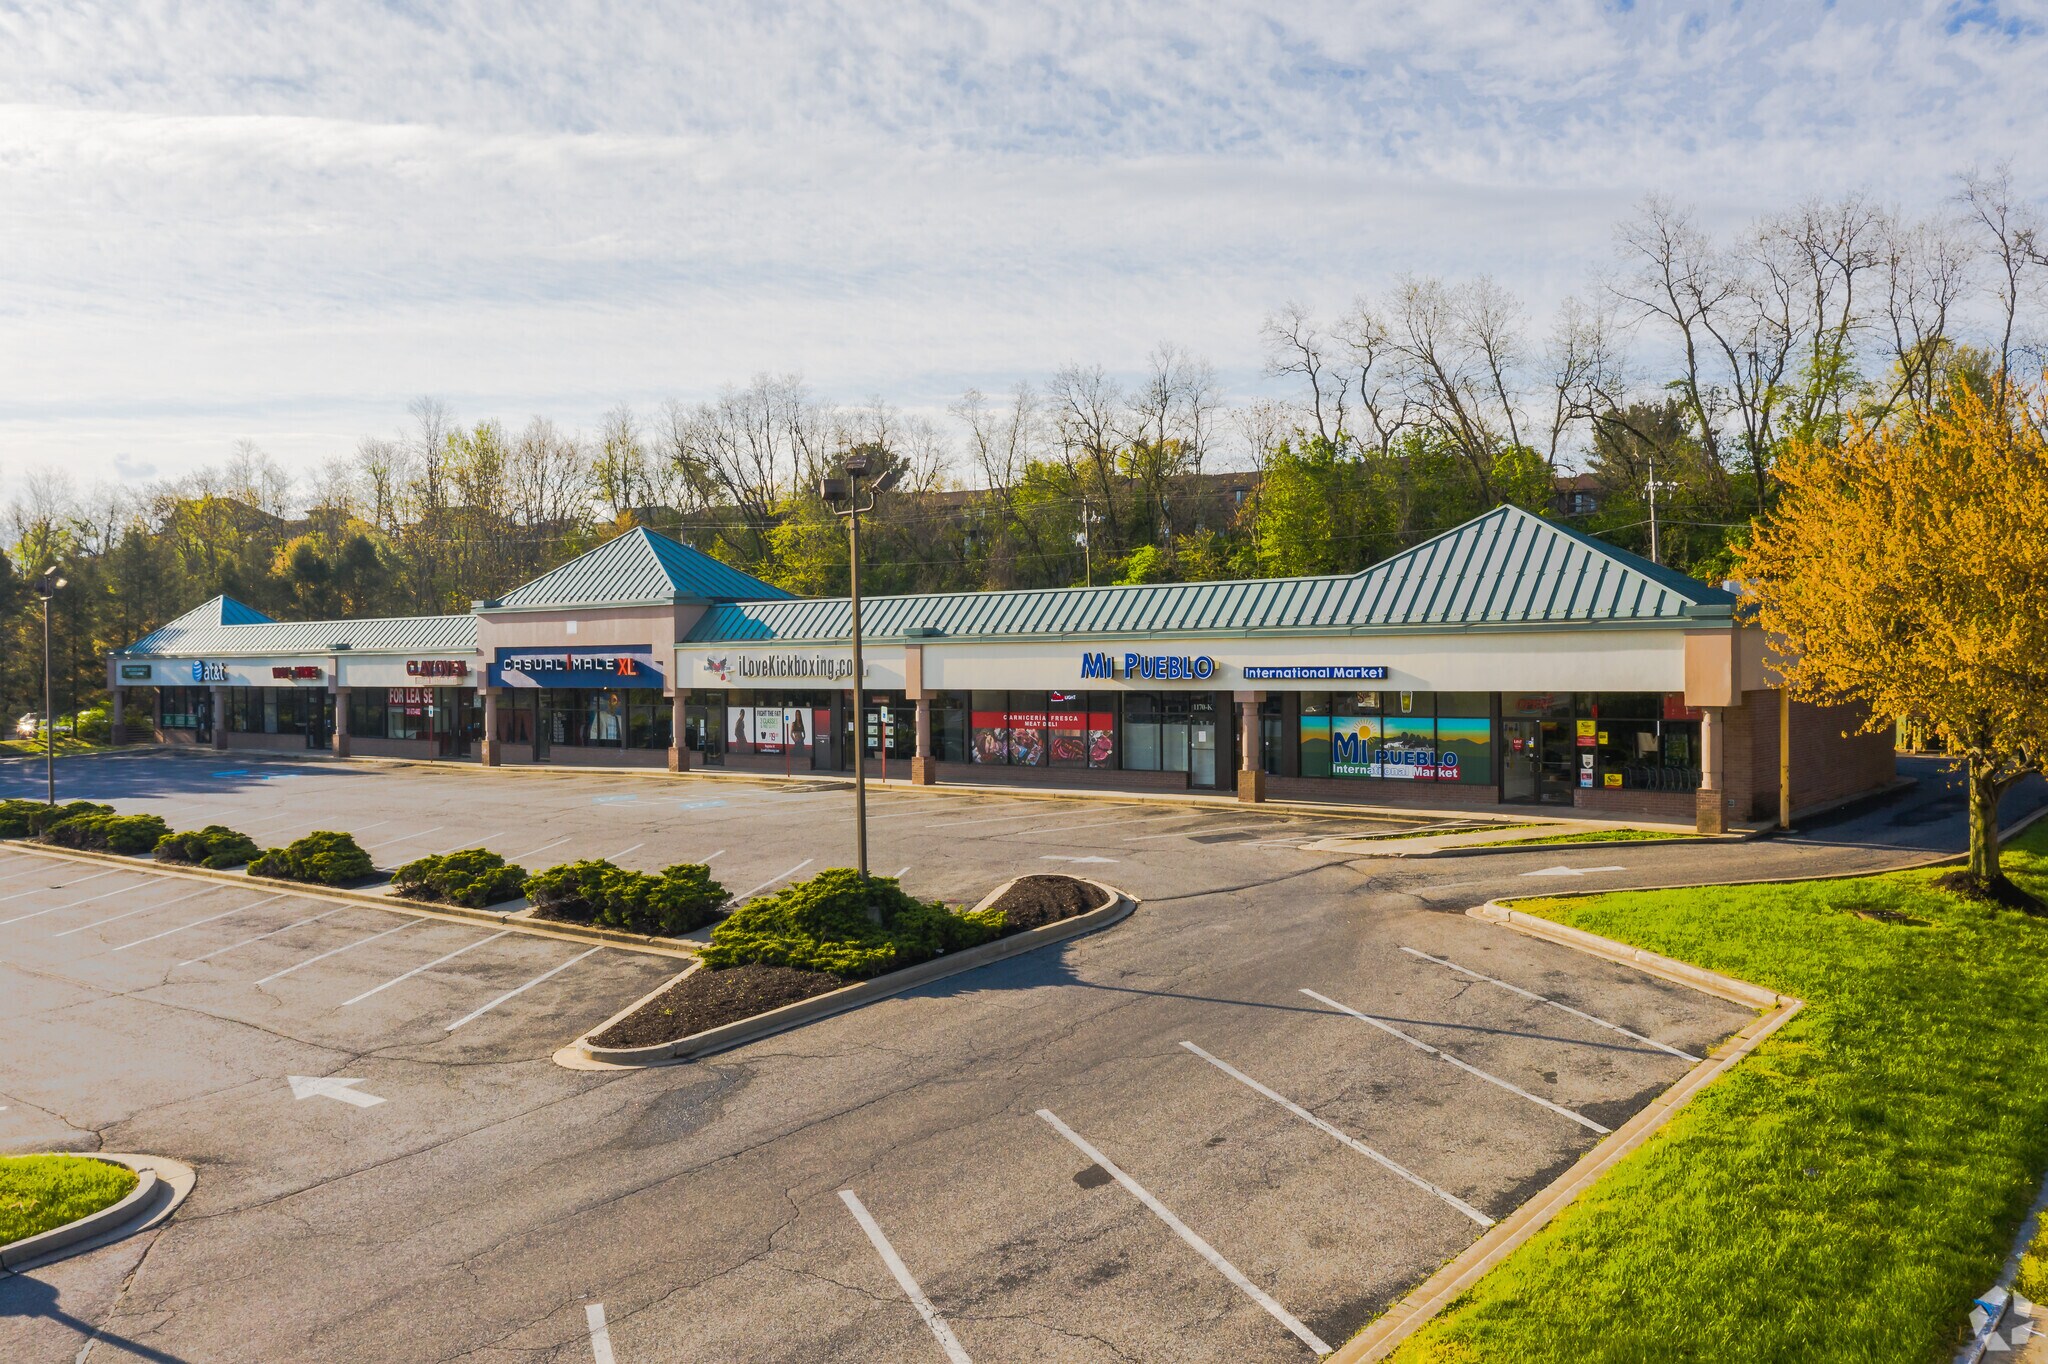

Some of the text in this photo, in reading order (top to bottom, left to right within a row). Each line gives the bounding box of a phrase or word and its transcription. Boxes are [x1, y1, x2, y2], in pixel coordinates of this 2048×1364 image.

[203, 664, 225, 681] at&t
[503, 659, 563, 670] CASUAL
[617, 658, 637, 675] XL
[1123, 652, 1214, 679] PUEBLO
[1245, 667, 1383, 679] International Market
[389, 688, 404, 704] FOR
[1374, 750, 1458, 767] PUEBLO
[1332, 763, 1458, 778] International Market
